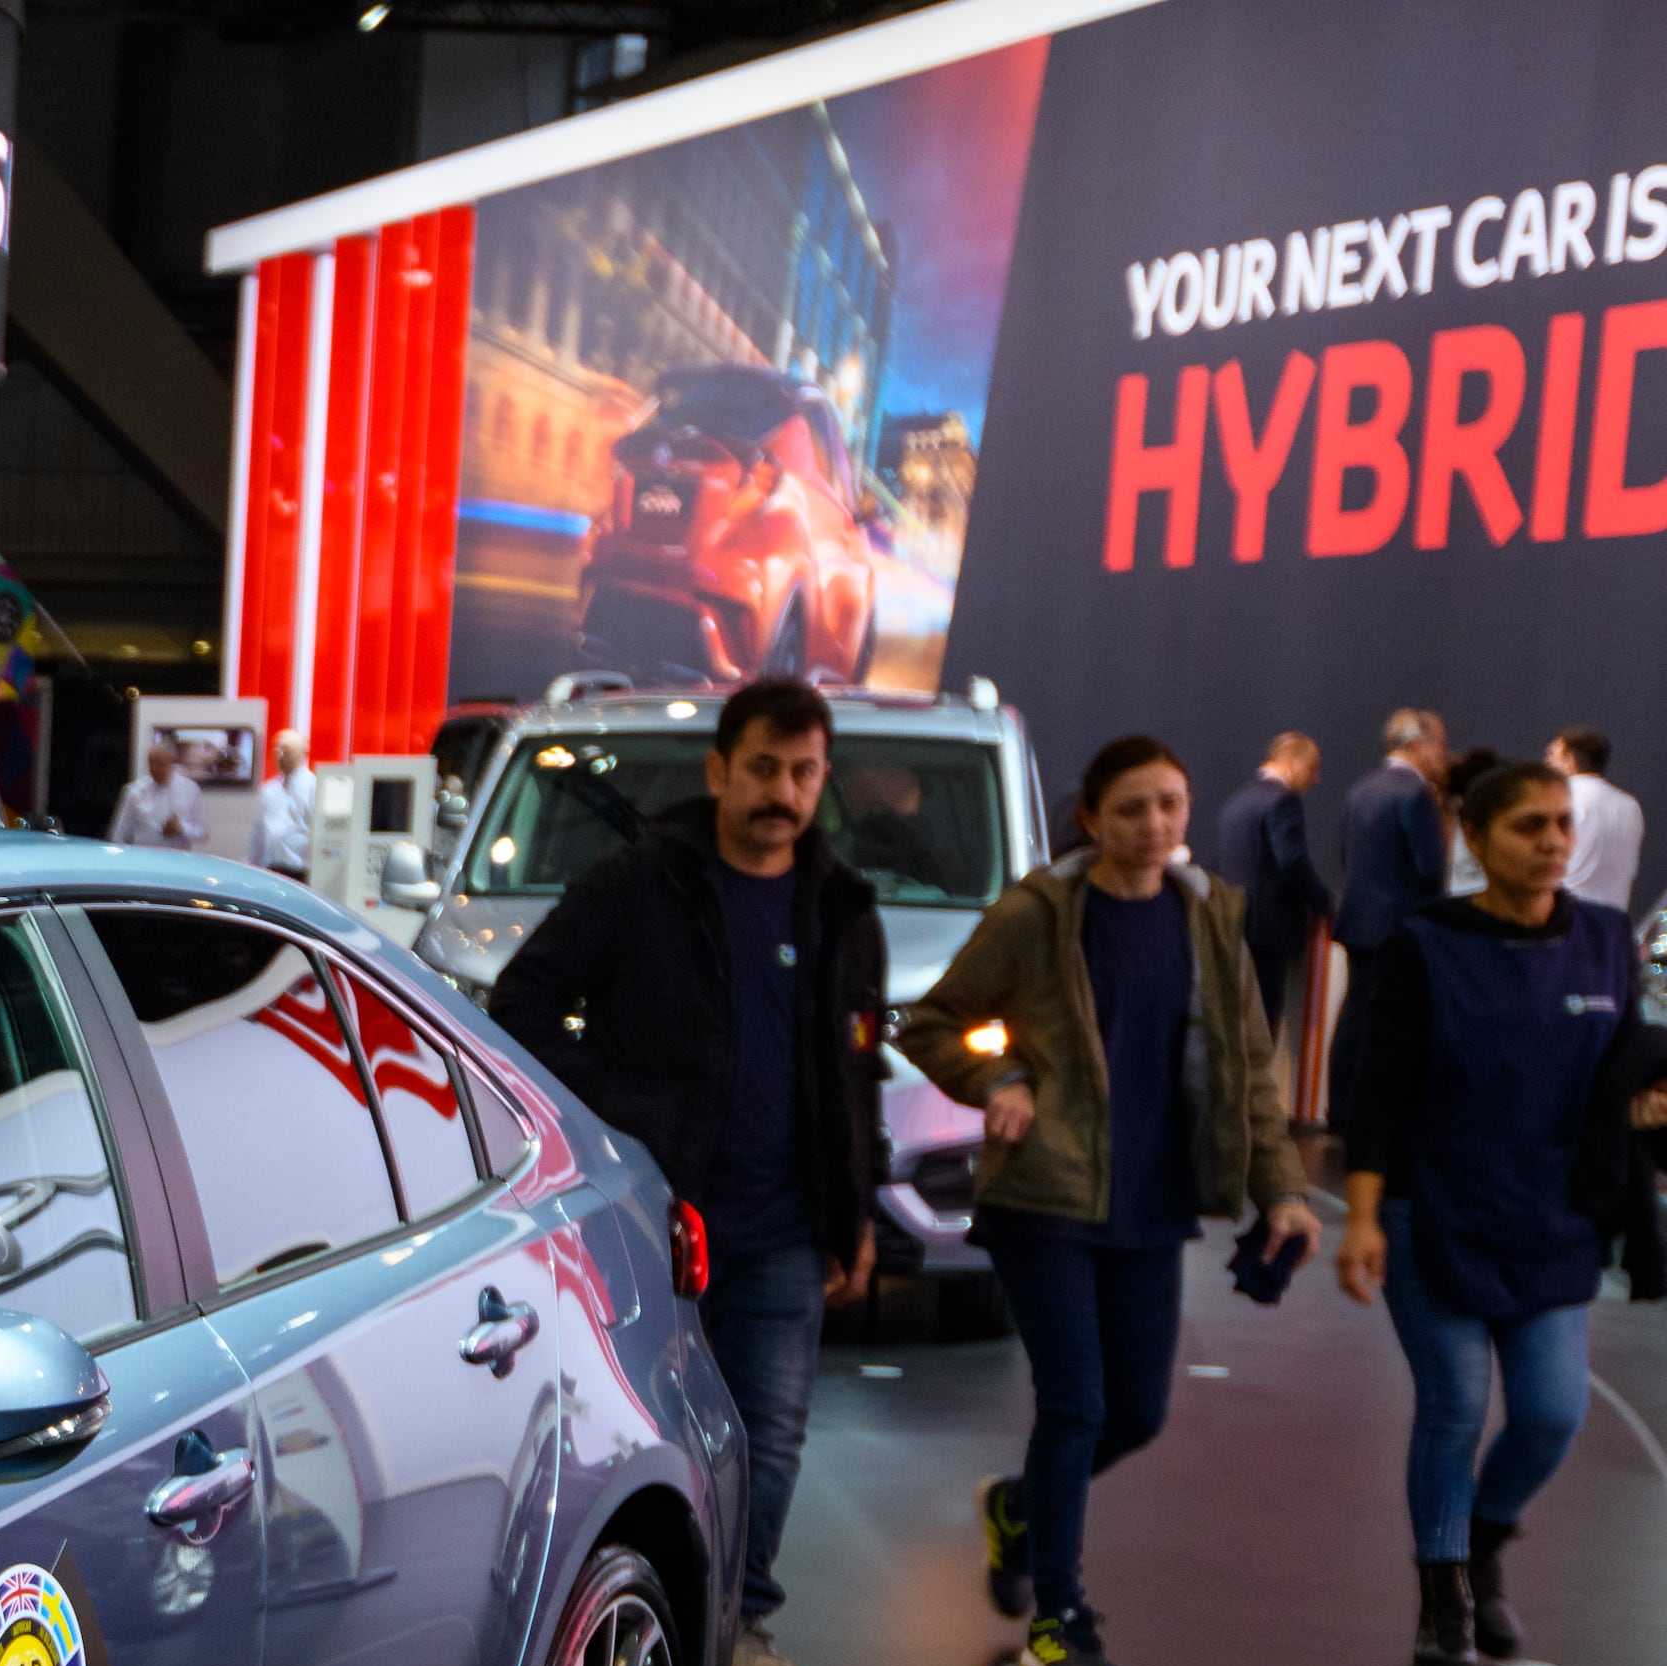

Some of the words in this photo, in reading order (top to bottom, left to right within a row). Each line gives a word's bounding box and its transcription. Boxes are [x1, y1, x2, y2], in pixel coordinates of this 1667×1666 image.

[1126, 237, 1277, 341] YOUR
[1281, 205, 1453, 317] NEXT
[1453, 179, 1597, 289] CAR
[1603, 163, 1667, 266] IS
[1102, 298, 1667, 575] HYBRID
